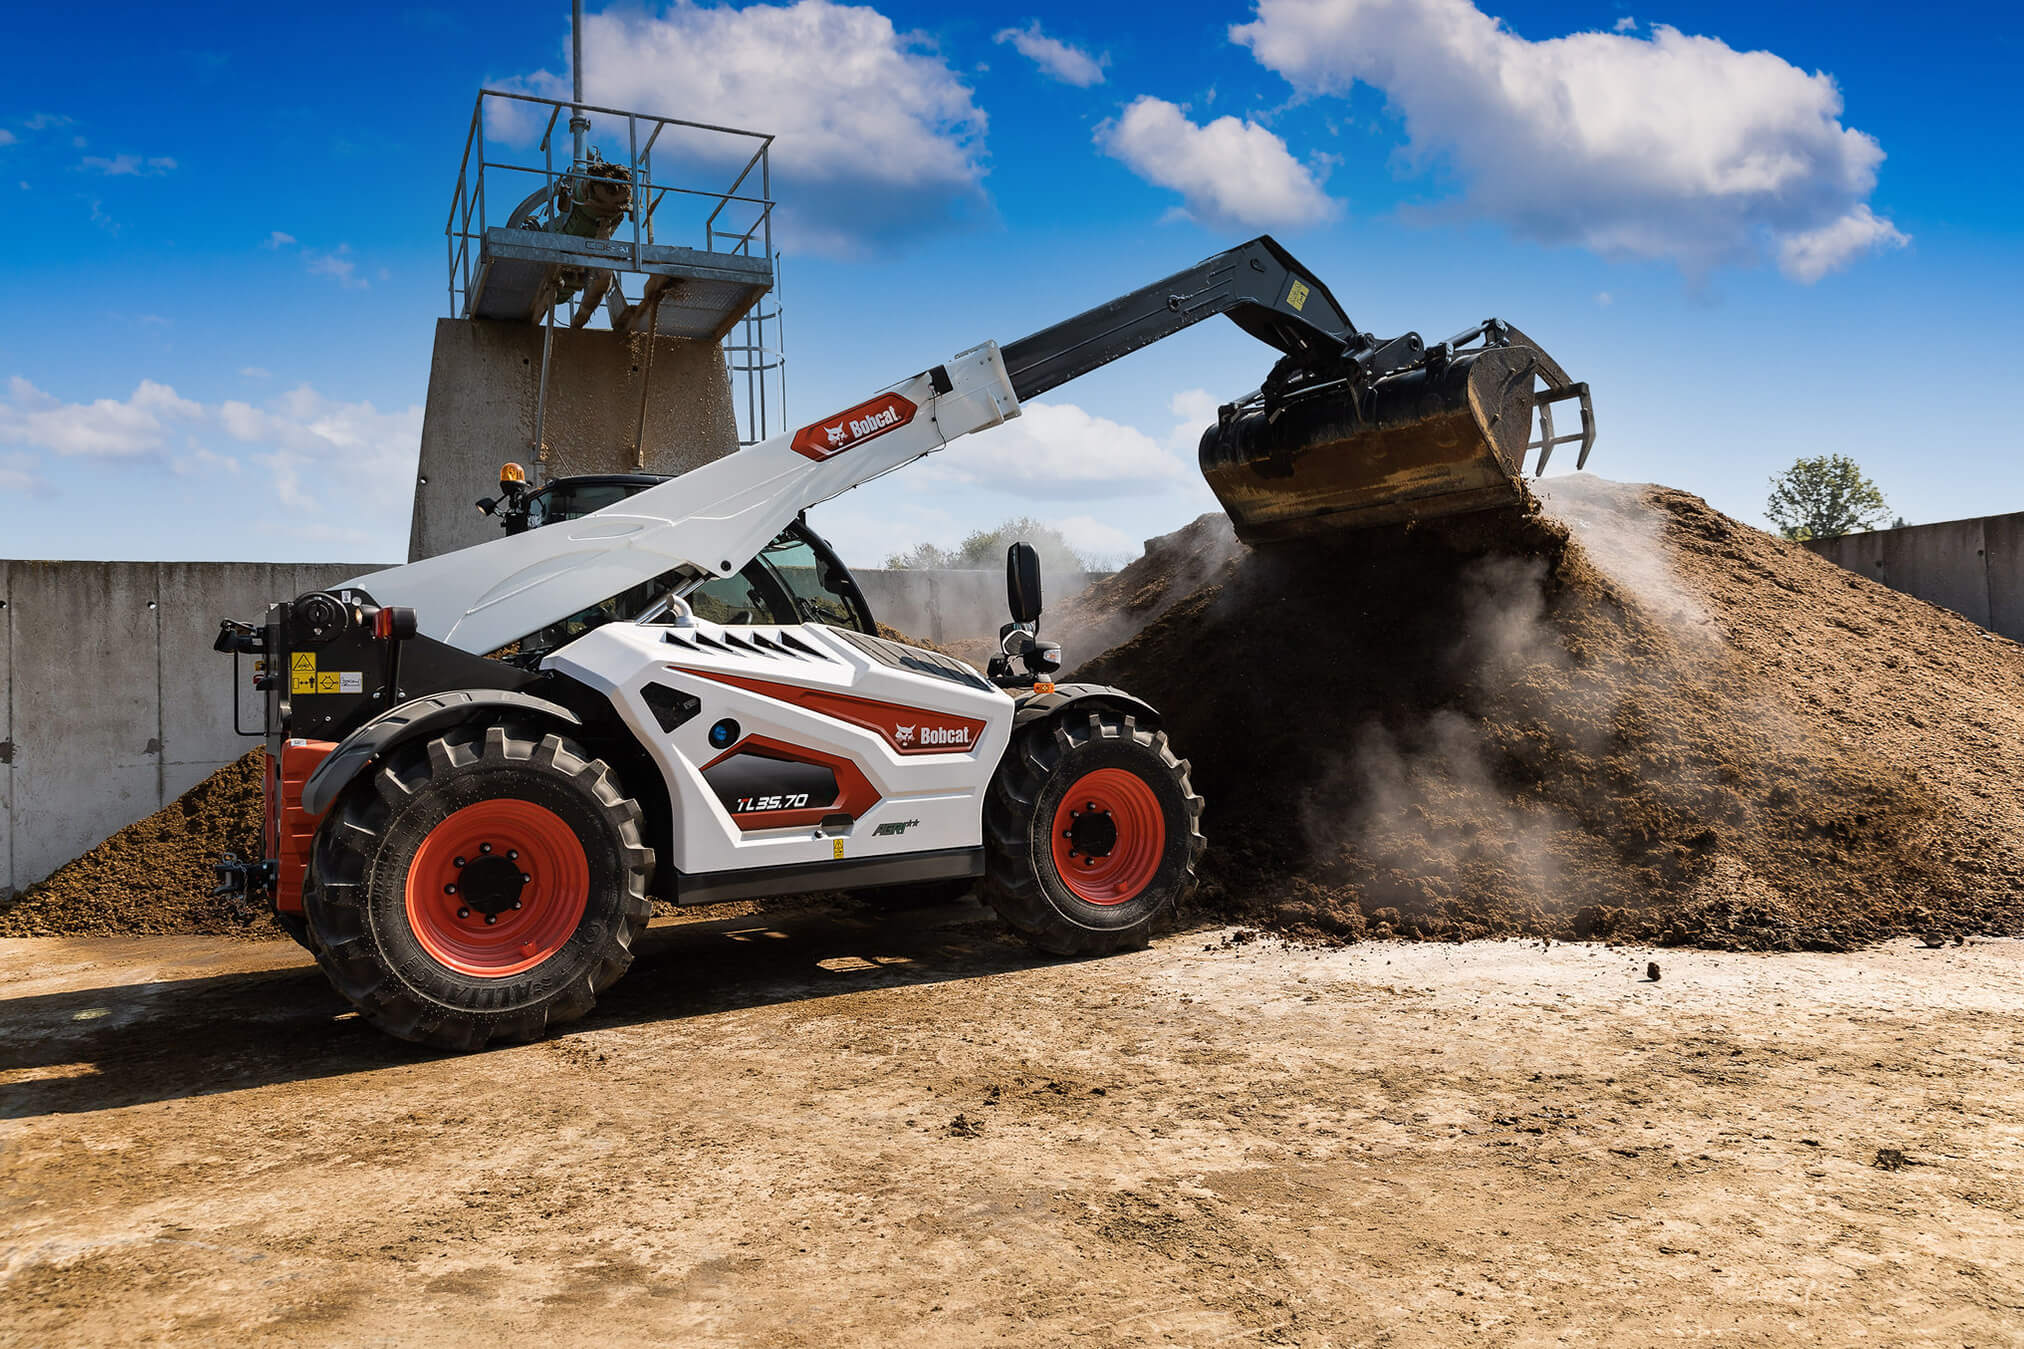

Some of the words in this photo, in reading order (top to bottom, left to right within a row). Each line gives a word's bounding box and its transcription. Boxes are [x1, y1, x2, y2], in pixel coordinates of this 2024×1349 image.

[849, 405, 899, 439] Bobcat
[920, 726, 969, 745] Bobcat
[737, 793, 809, 812] TL35.70
